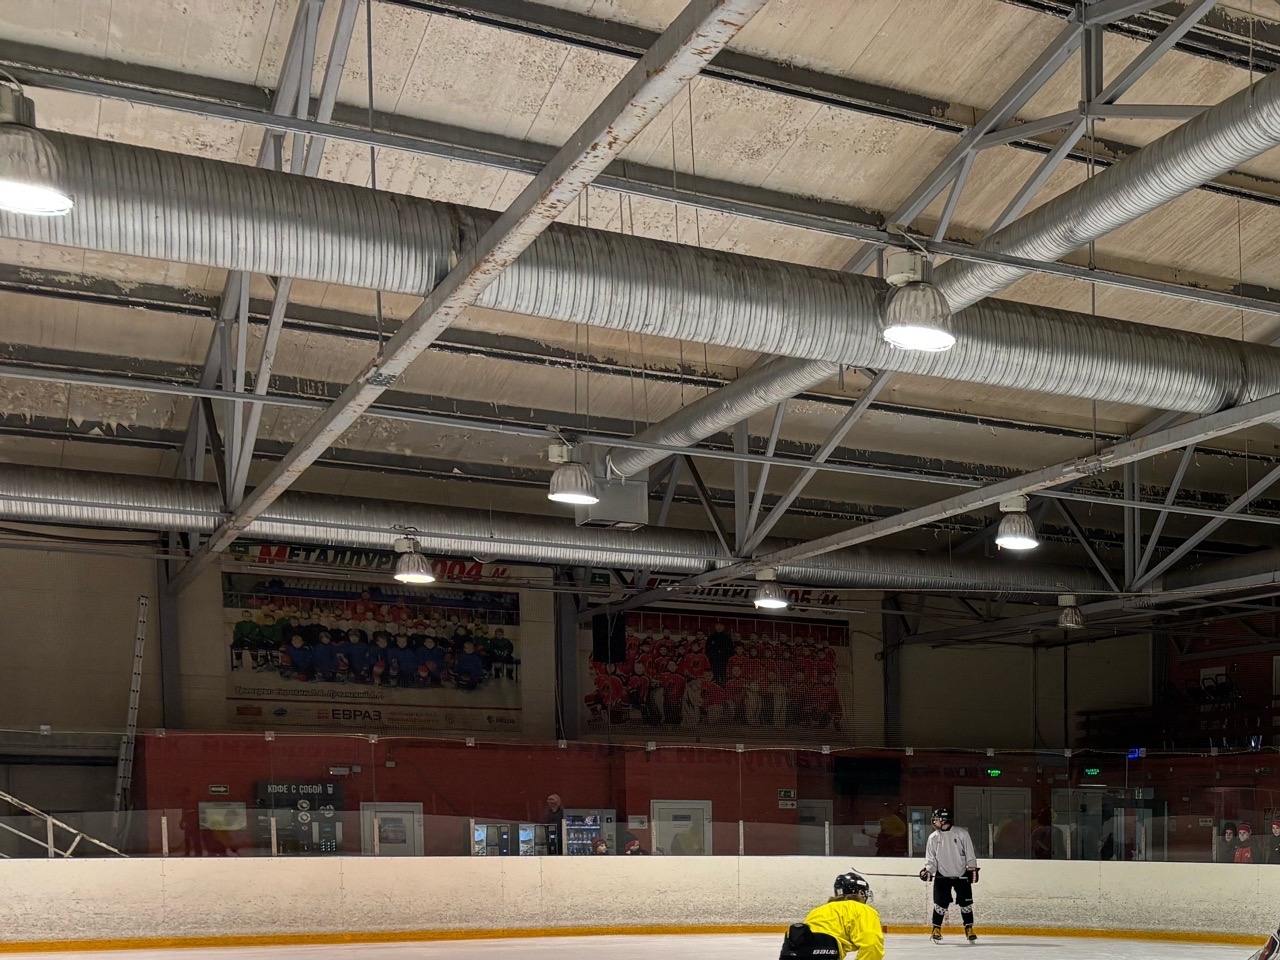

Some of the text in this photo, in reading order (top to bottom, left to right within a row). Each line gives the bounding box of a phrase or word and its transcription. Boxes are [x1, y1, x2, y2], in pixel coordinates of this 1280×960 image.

[331, 708, 382, 721] ЕВРАЗ
[267, 784, 289, 794] КОФЕ
[299, 783, 323, 794] СОБОЙ
